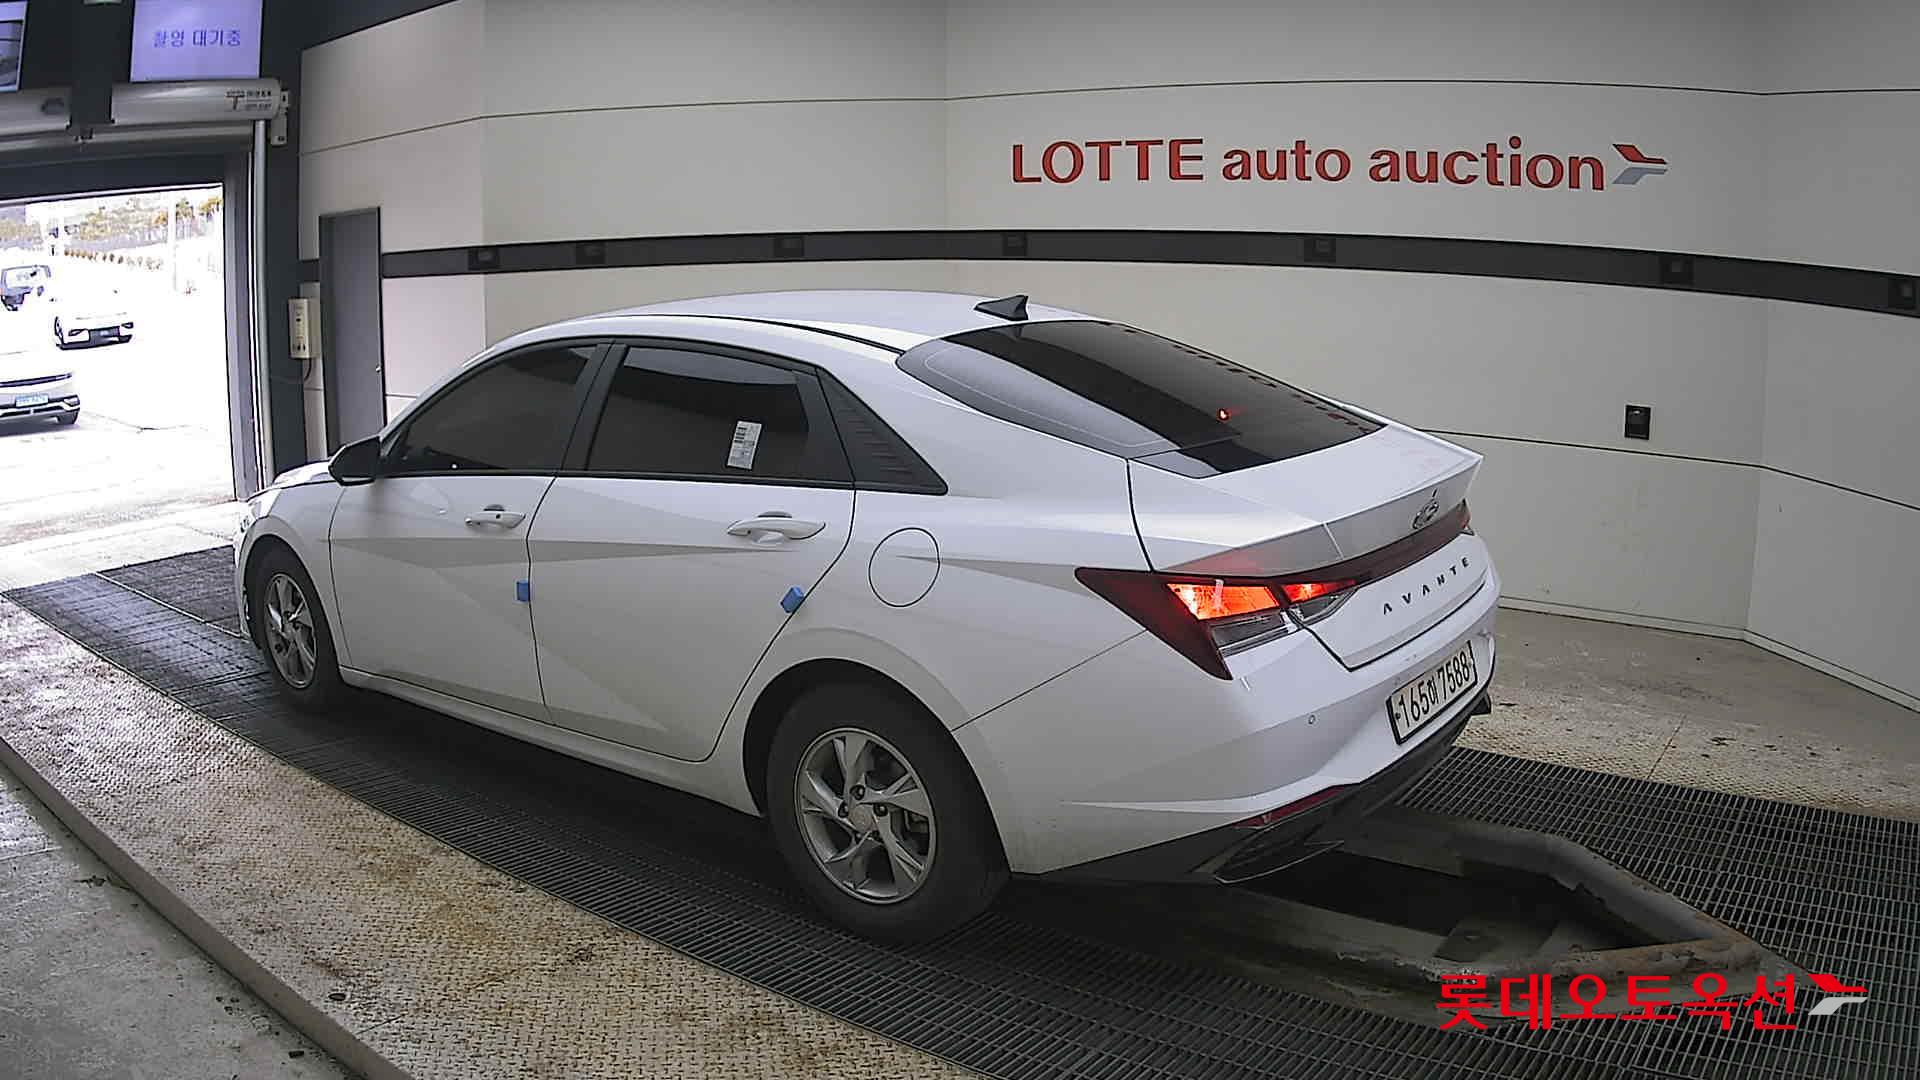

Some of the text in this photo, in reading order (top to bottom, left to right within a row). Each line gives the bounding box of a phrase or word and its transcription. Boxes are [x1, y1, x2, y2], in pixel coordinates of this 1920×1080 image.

[192, 29, 241, 47] 대기중
[1012, 135, 1605, 191] LOTTE auto auction
[1383, 557, 1469, 615] AVANTE
